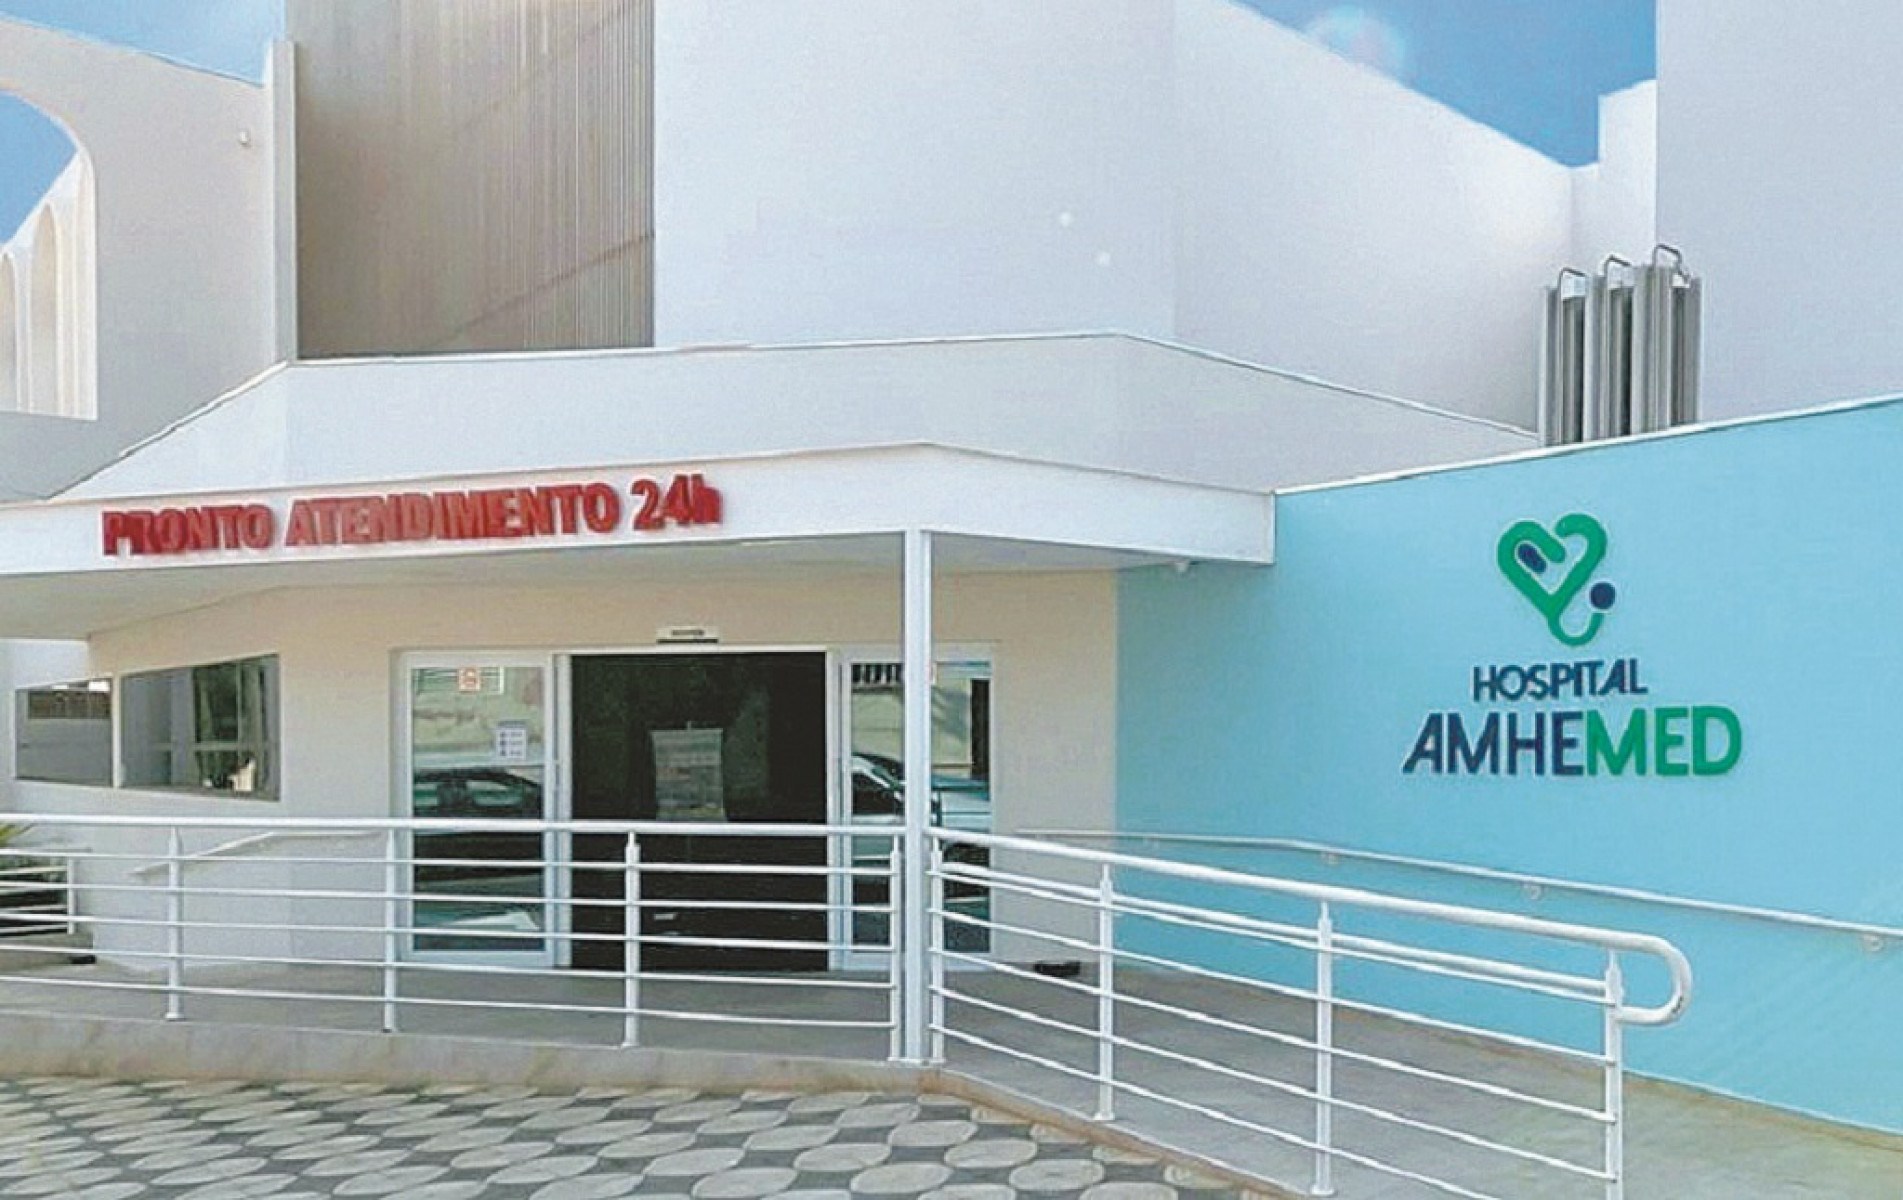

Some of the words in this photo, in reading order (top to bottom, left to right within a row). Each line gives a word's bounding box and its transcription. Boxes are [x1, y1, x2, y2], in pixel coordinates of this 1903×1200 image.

[103, 505, 272, 555] PRONTO
[286, 482, 621, 547] ATENDIMENTO
[632, 474, 722, 532] 24h
[1473, 658, 1648, 702] HOSPITAL
[1402, 705, 1742, 777] AMHEMED
